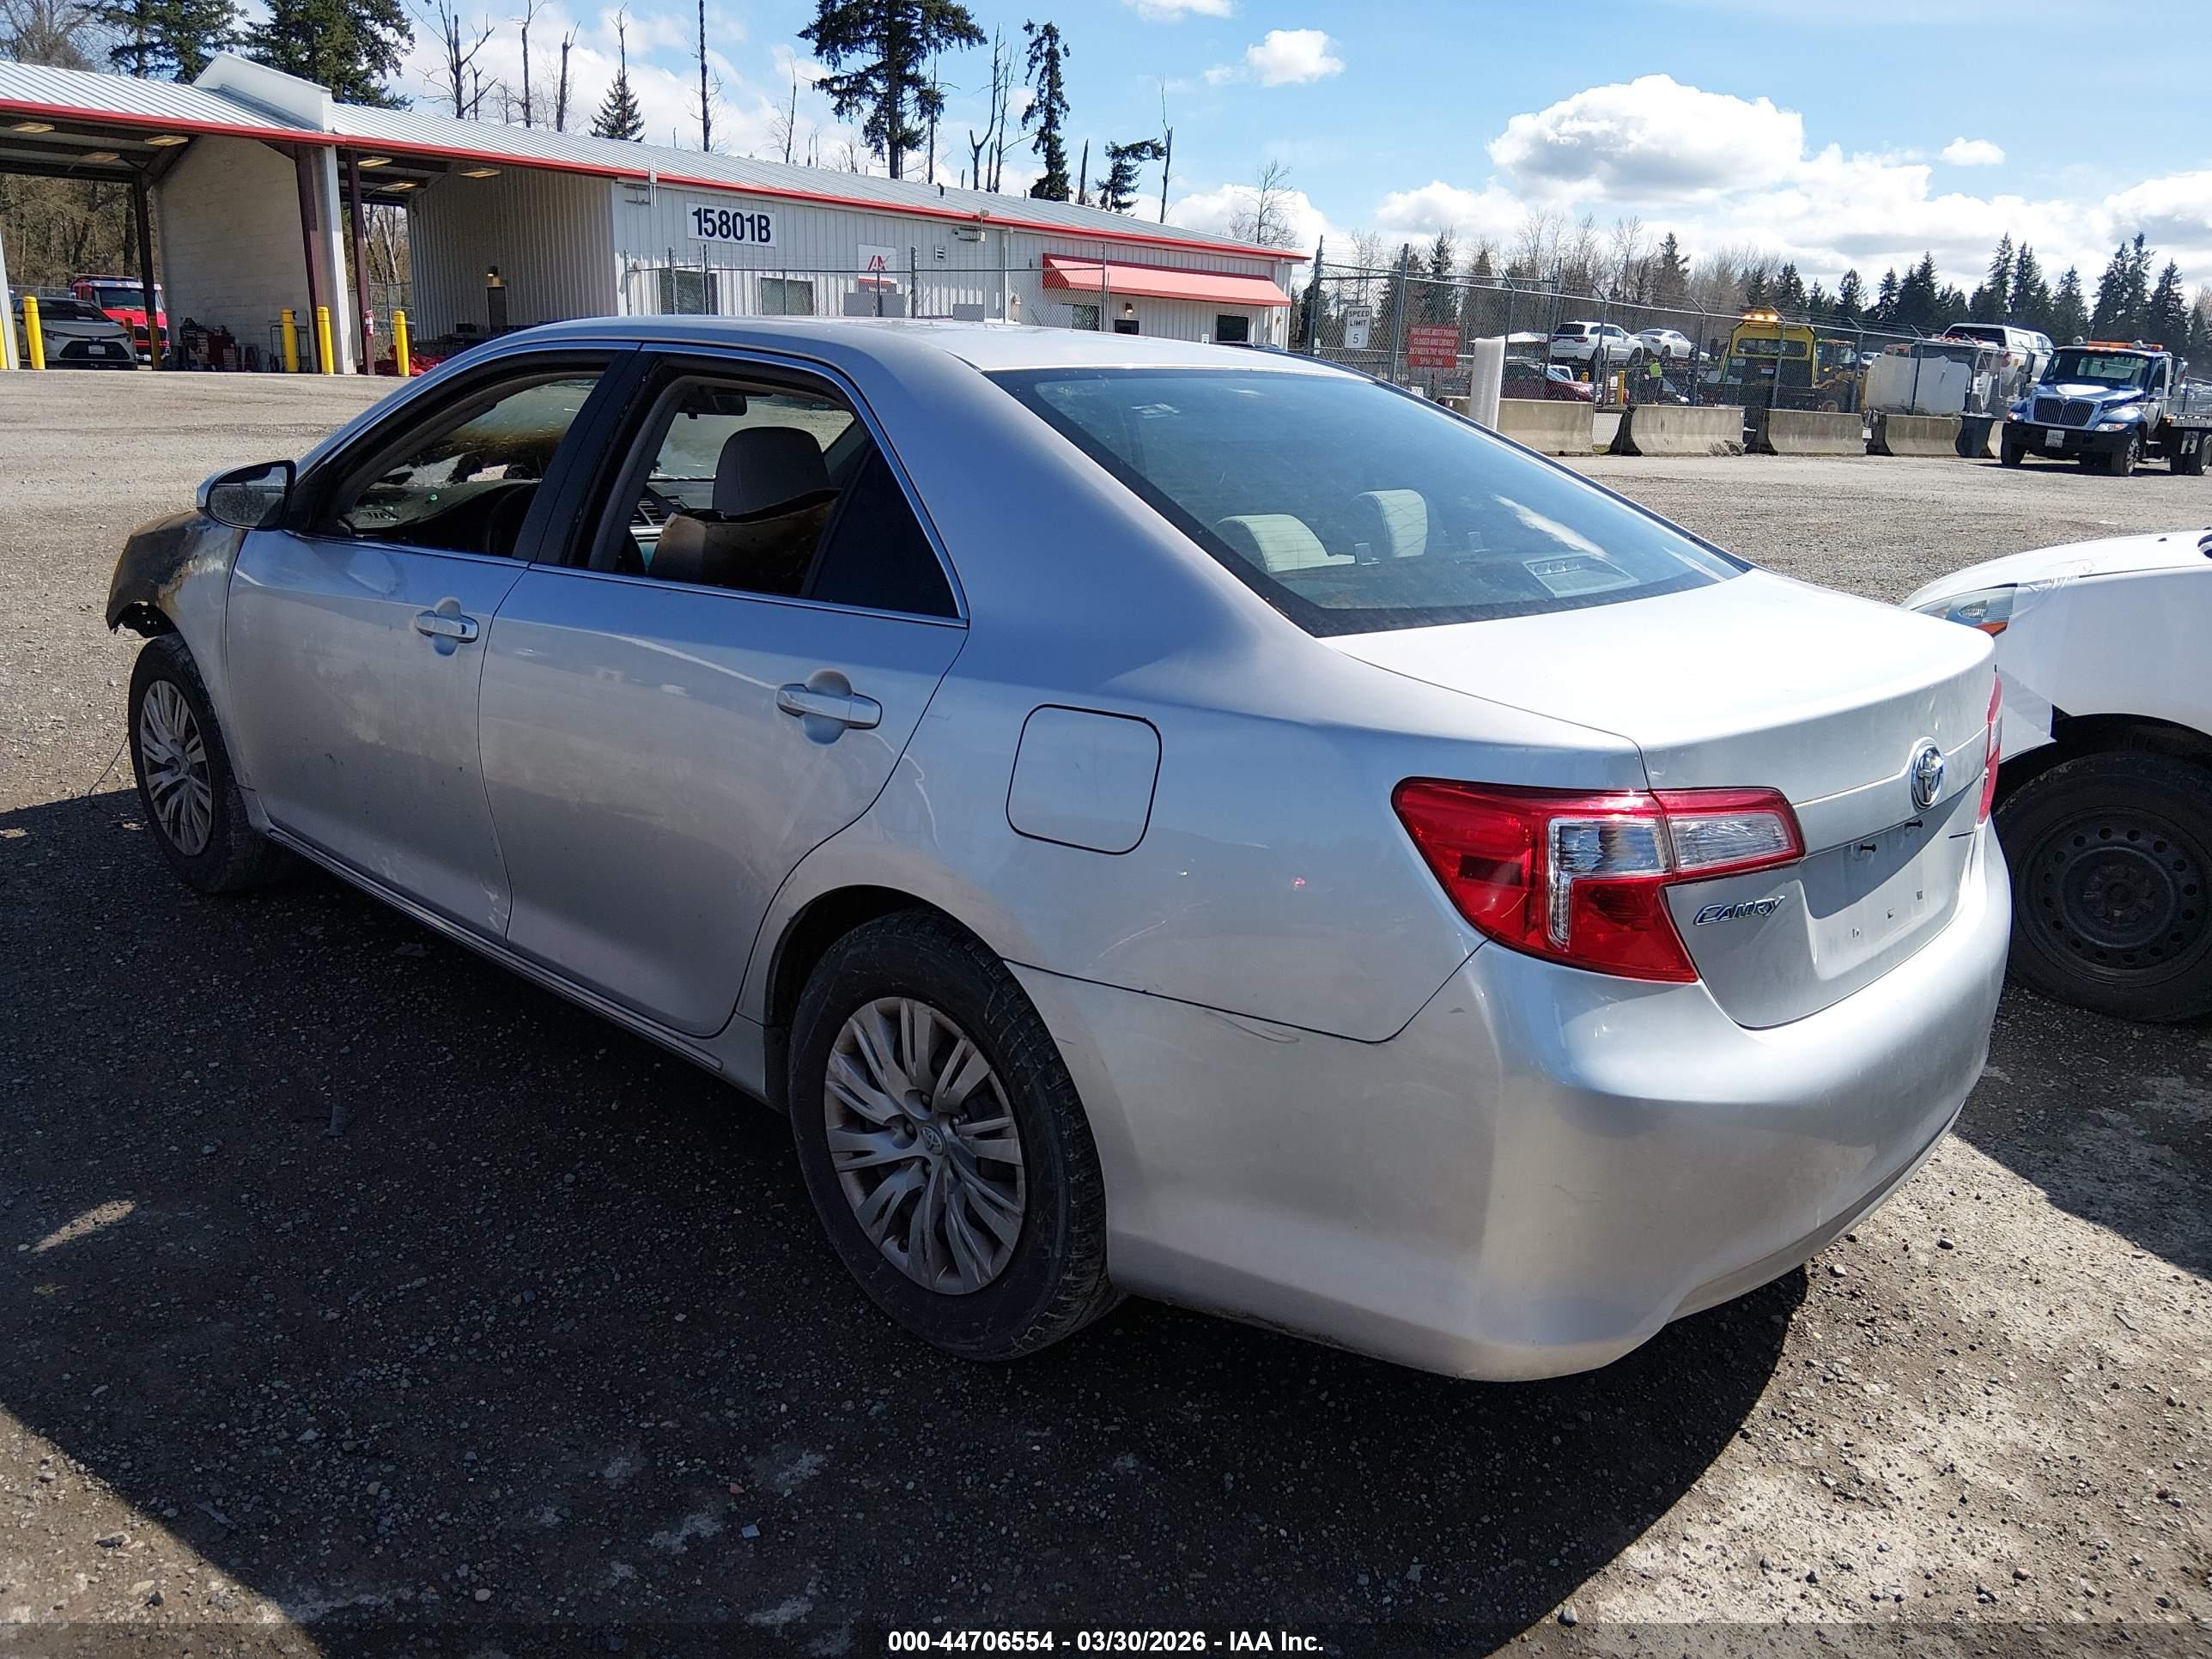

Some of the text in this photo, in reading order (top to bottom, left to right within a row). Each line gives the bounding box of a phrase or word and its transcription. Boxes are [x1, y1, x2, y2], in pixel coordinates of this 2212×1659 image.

[692, 207, 771, 243] 15801B
[1352, 333, 1359, 343] 5
[1693, 895, 1786, 926] CAMRY
